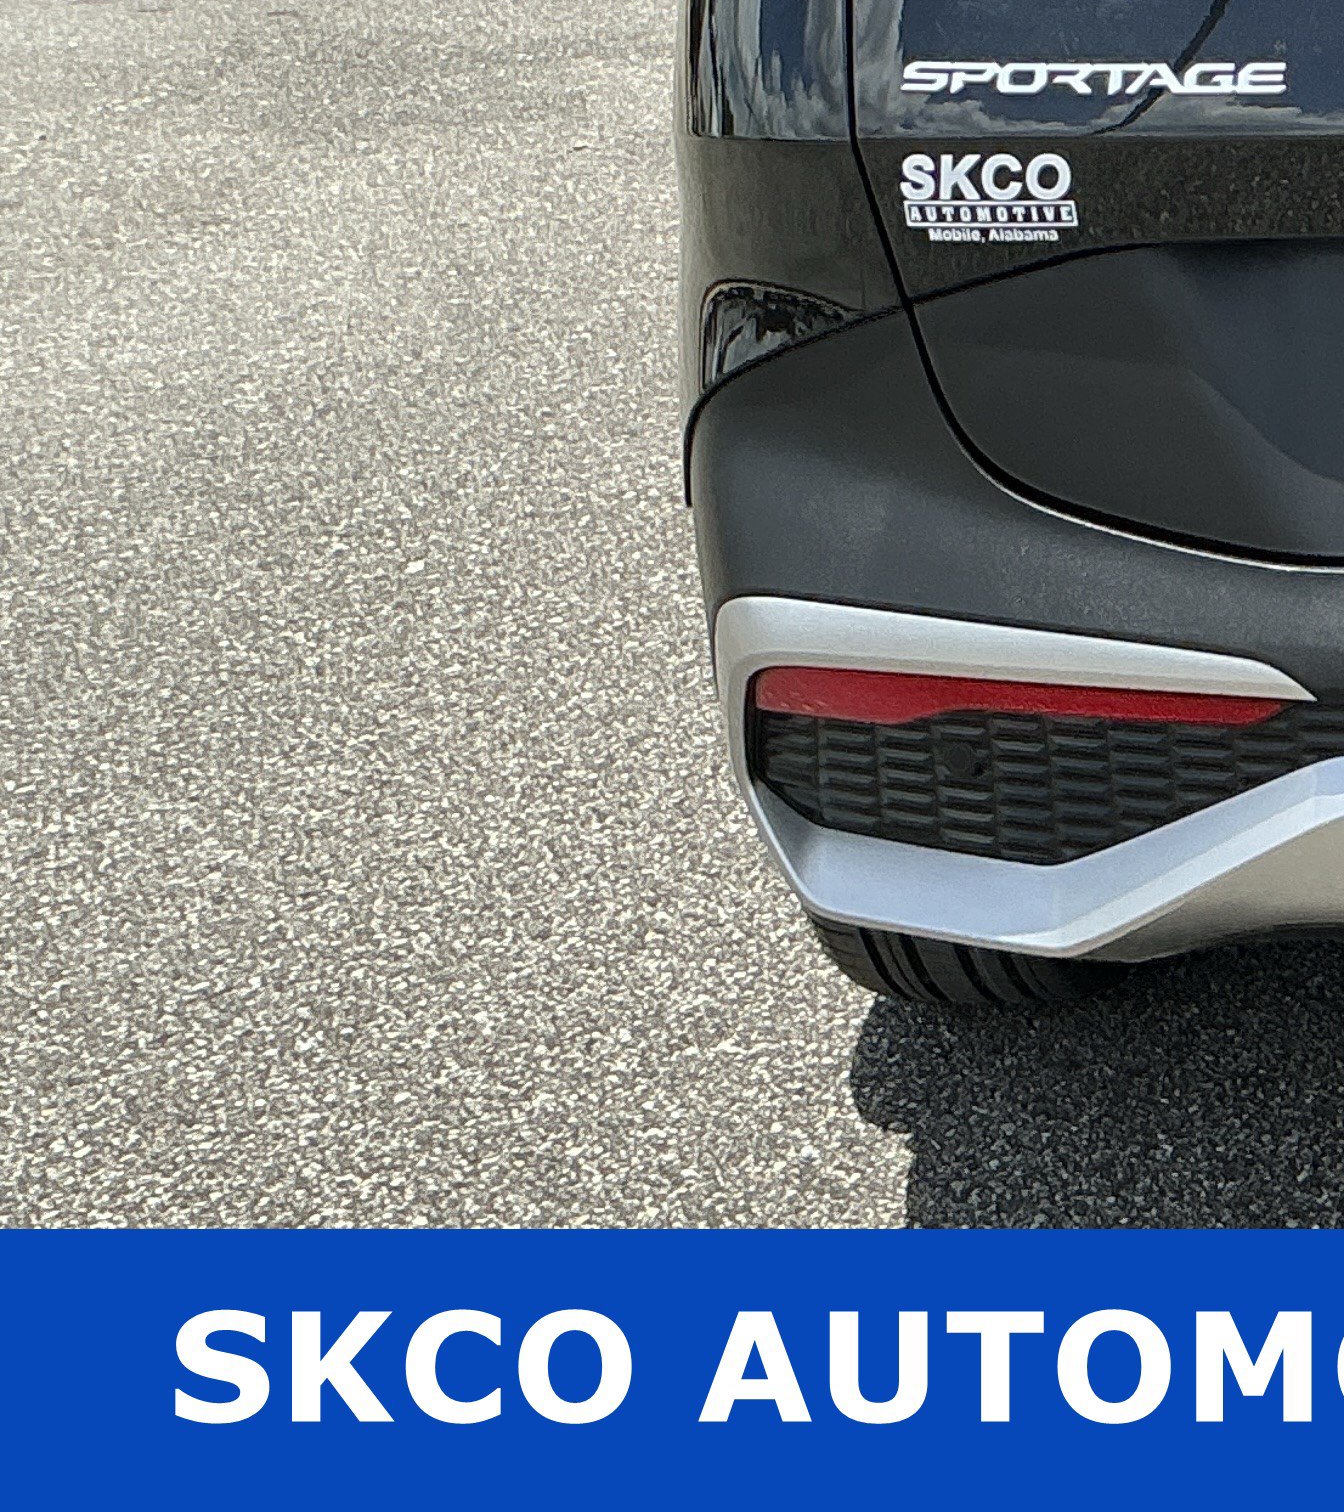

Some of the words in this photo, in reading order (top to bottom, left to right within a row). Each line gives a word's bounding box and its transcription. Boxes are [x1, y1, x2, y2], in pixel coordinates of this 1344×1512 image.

[901, 61, 1287, 94] SPORTAGE
[901, 153, 1072, 200] SKCO
[910, 205, 1073, 223] AUTOMOTIVE
[929, 229, 986, 243] Mobile,
[989, 229, 1059, 242] Alabama
